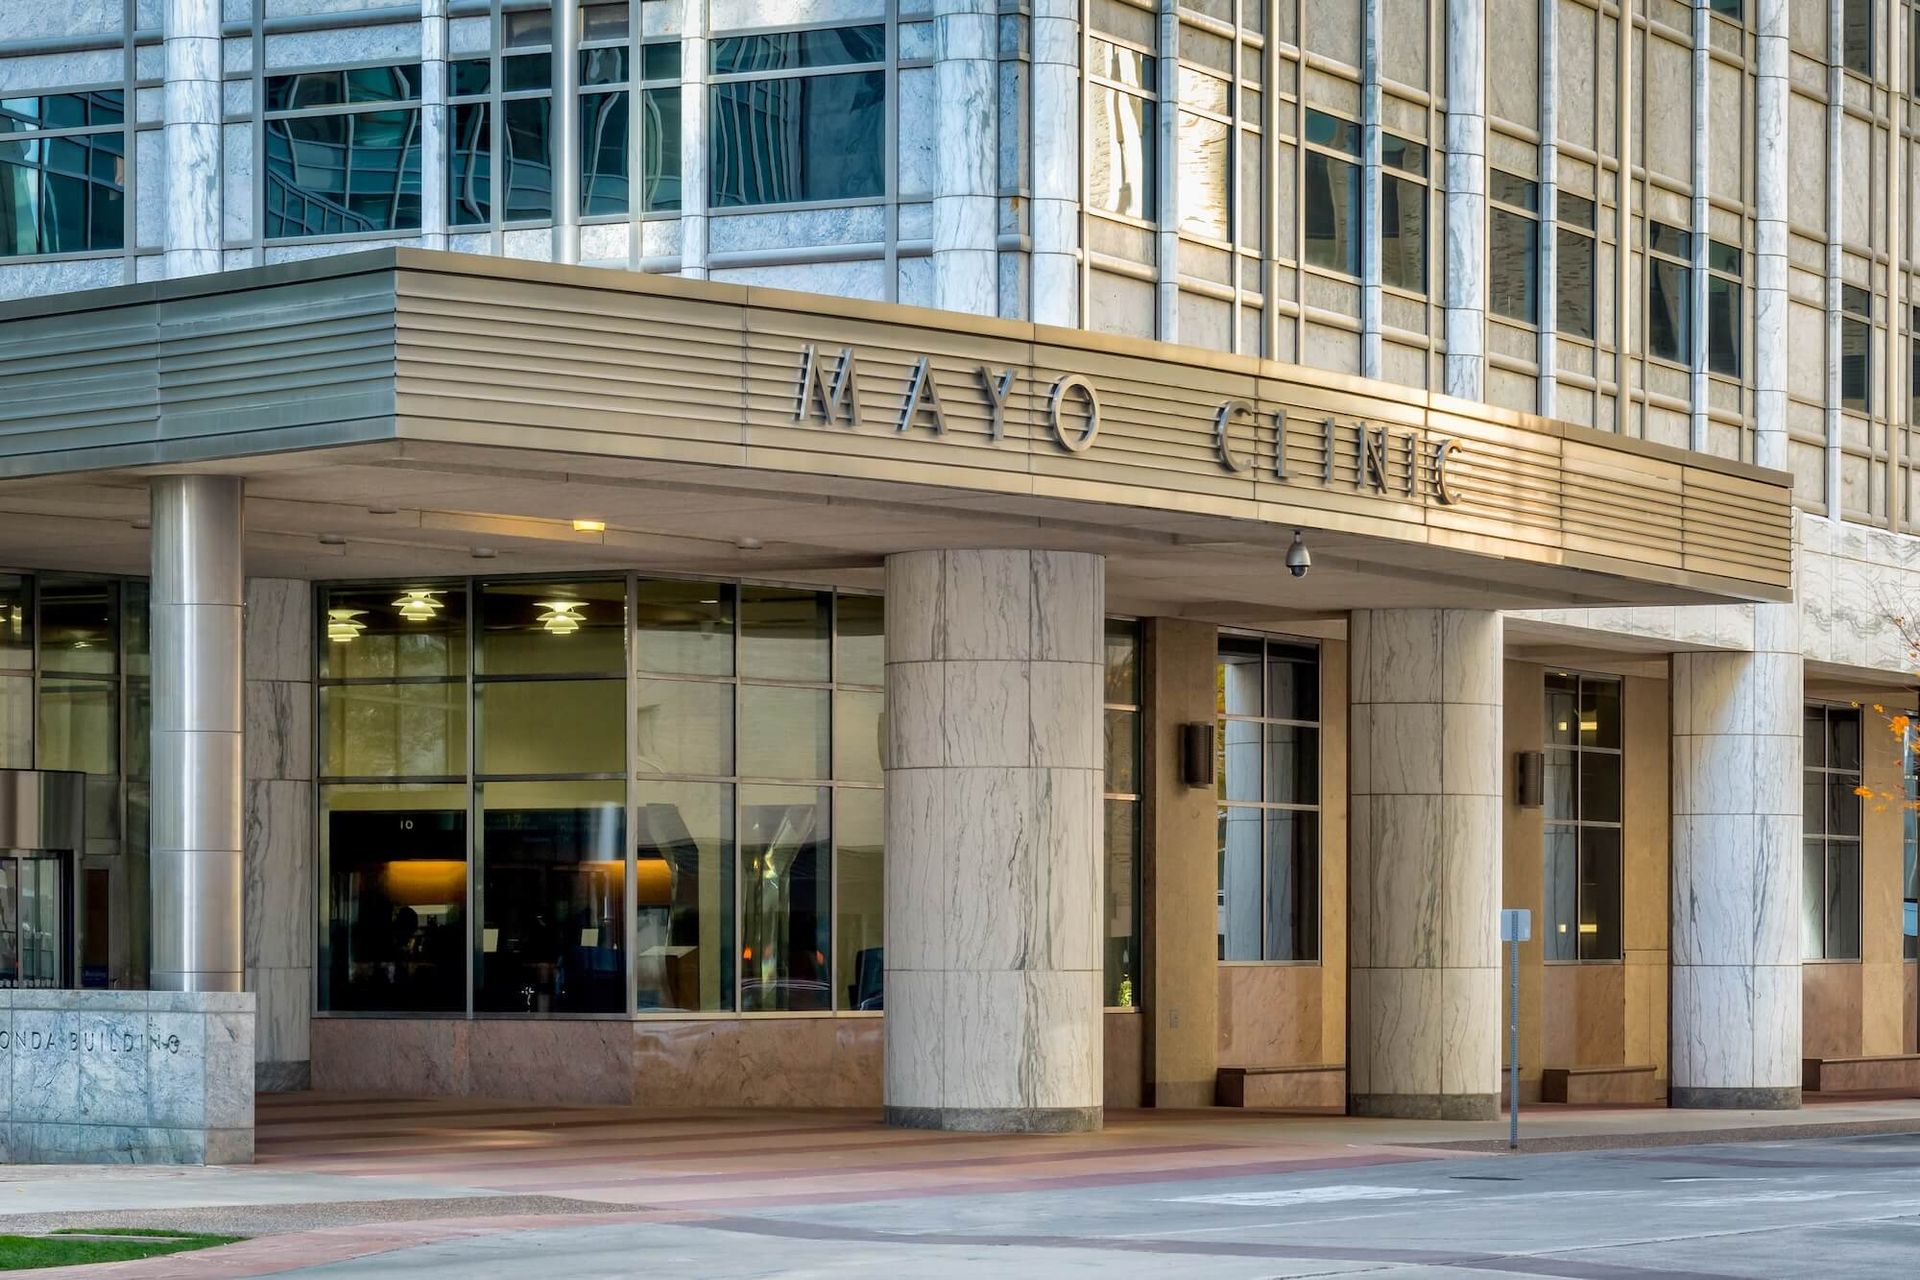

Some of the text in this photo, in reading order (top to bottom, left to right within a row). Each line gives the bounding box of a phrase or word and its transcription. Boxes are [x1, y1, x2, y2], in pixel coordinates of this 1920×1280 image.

[796, 343, 1463, 505] MAYO CLINIC
[0, 1030, 180, 1054] ONDA BUILDING
